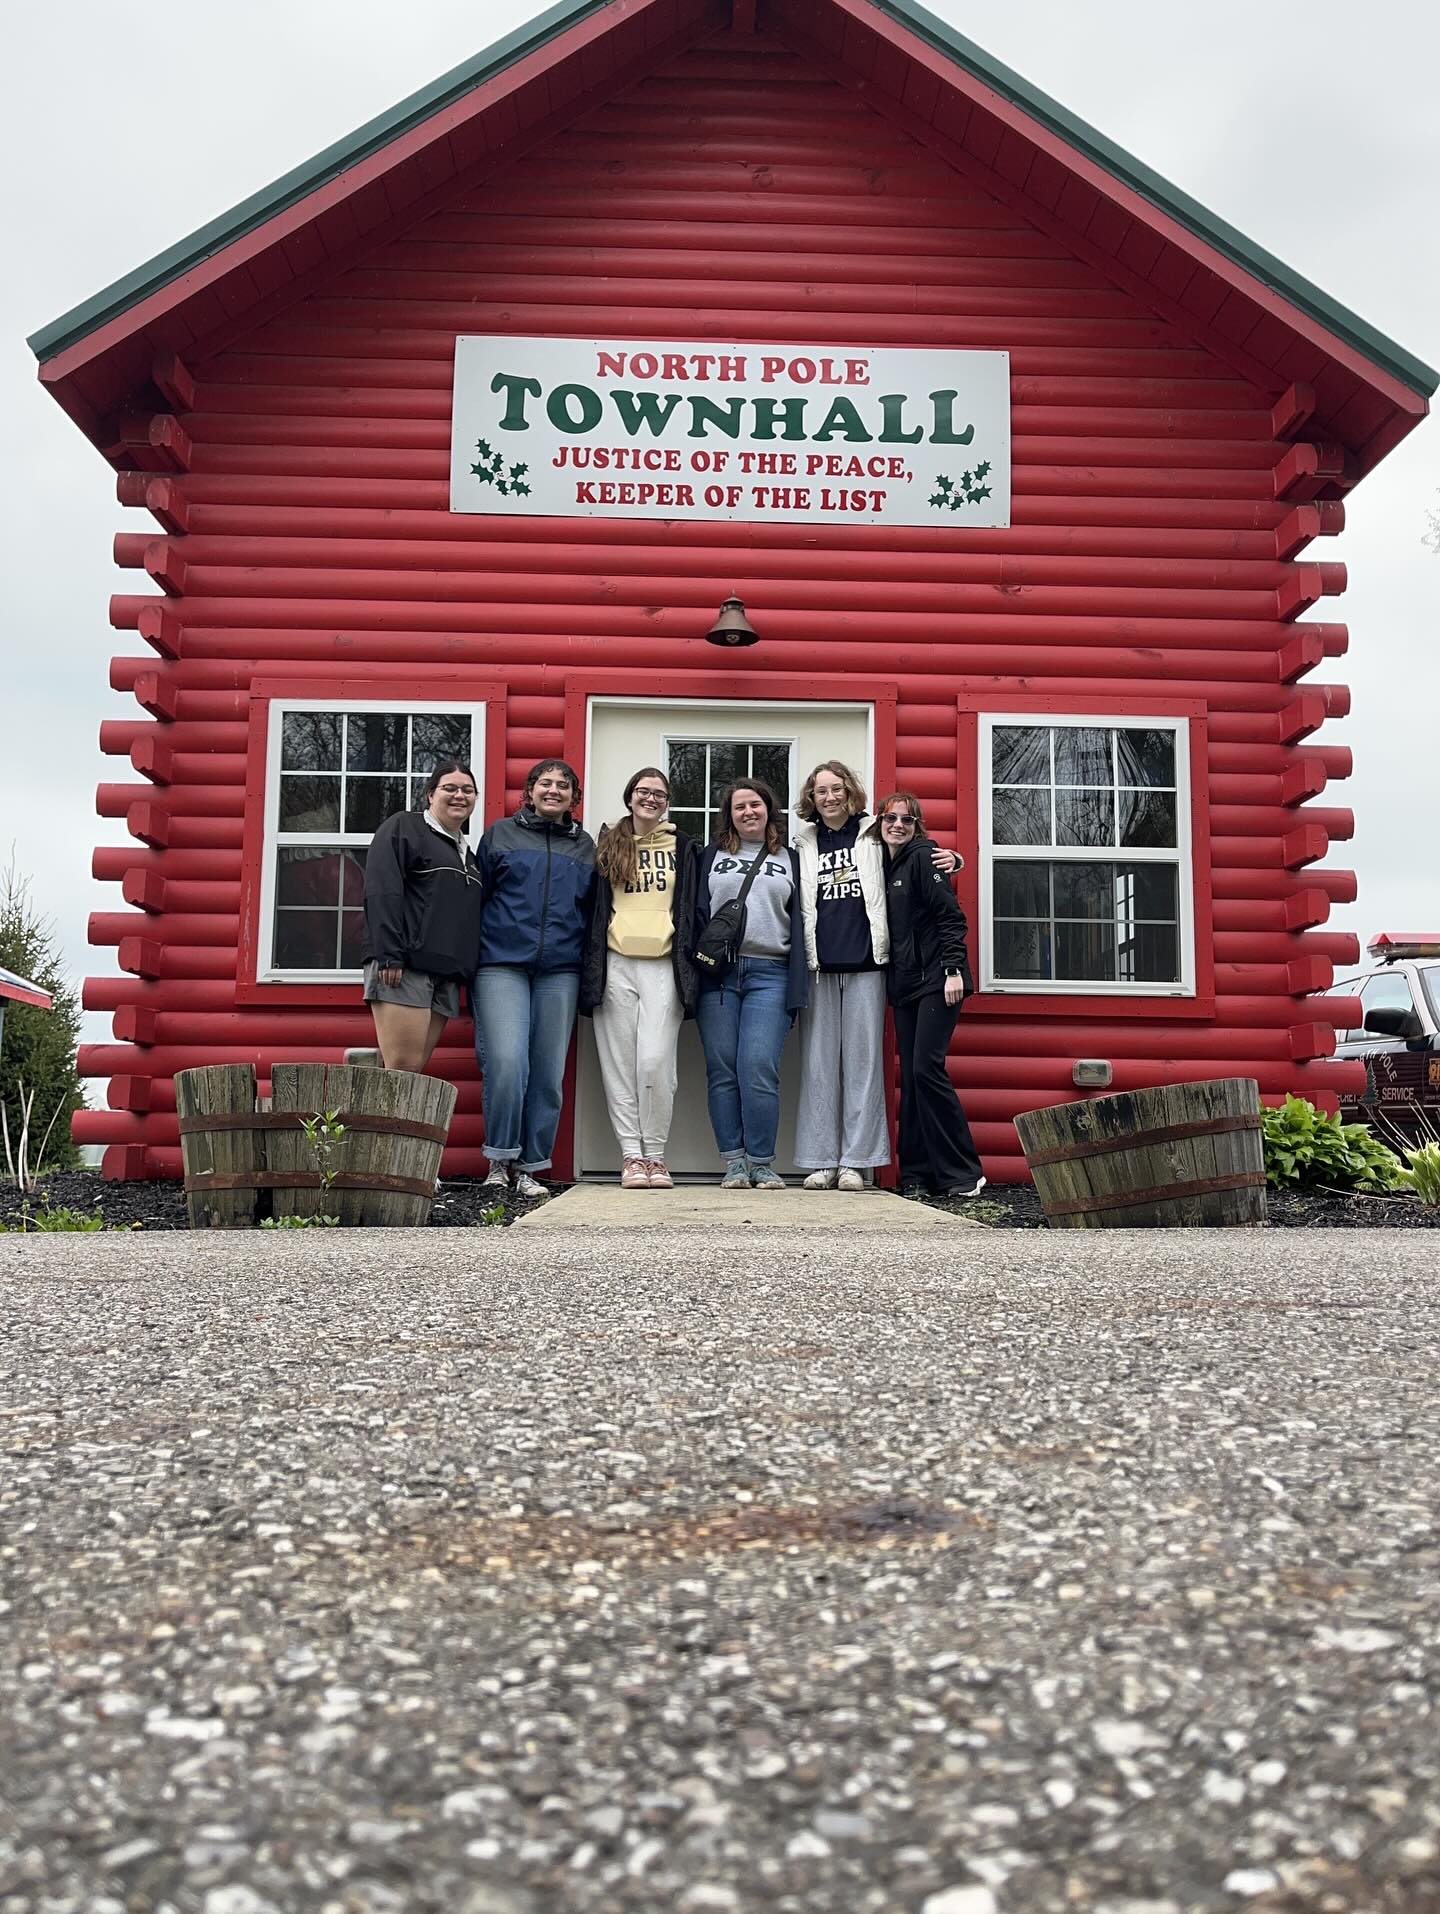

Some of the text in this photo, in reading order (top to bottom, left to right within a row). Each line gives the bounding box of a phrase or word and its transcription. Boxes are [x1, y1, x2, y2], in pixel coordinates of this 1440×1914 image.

[598, 351, 870, 385] NORTH POLE
[490, 372, 975, 446] TOWNHALL
[552, 447, 914, 483] JUSTICE OF THE PEACE,
[576, 481, 887, 512] KEEPER OF THE LIST
[822, 882, 861, 900] ZIPS
[696, 951, 716, 966] ZIPS
[1381, 1087, 1415, 1101] SERVICE
